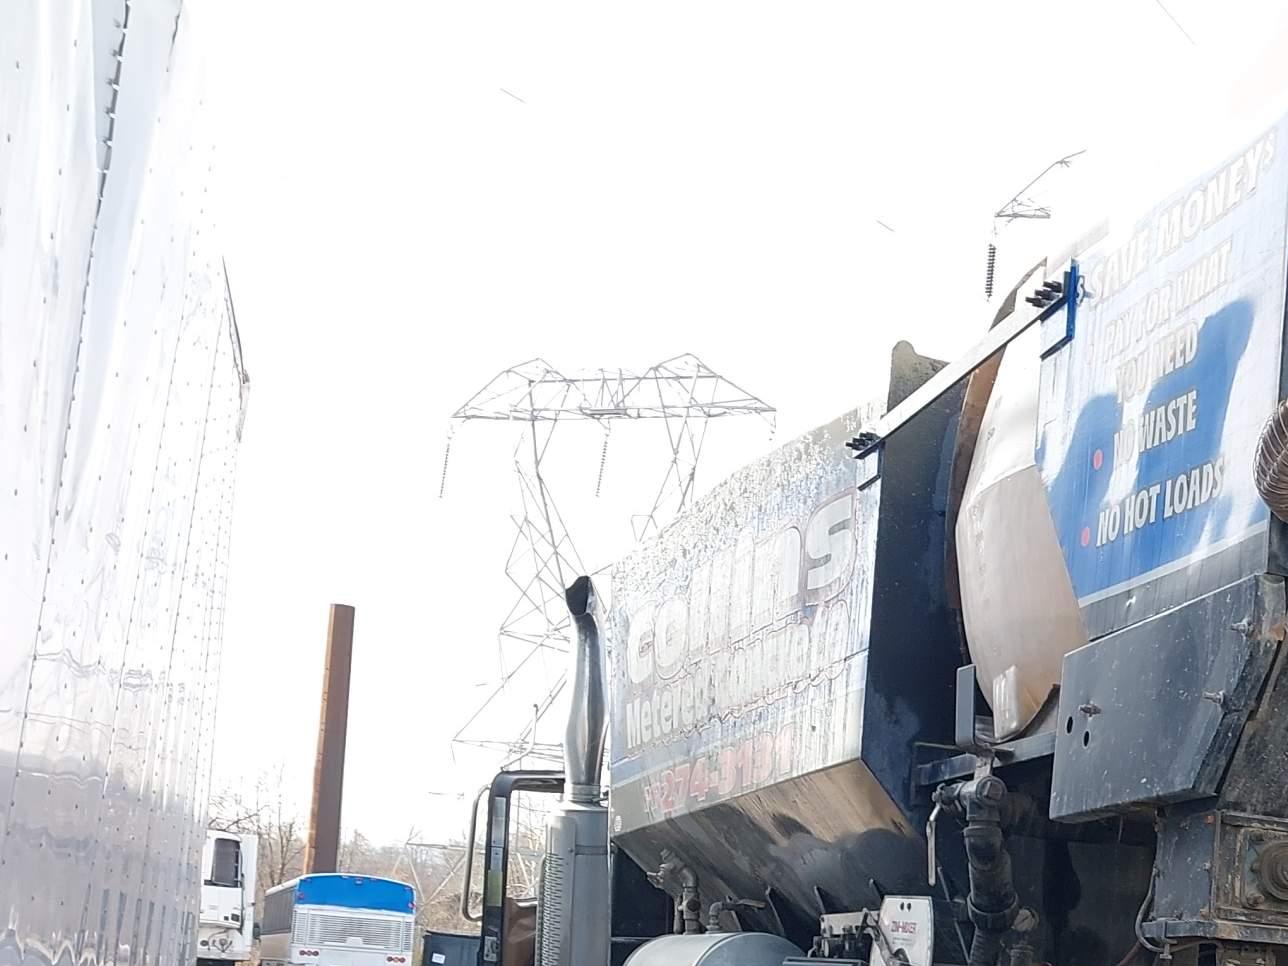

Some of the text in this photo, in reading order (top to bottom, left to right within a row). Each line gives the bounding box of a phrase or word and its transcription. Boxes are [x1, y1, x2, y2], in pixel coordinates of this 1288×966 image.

[1091, 230, 1150, 306] SAVE
[1104, 234, 1233, 364] PAY FOR WHAT
[1116, 320, 1198, 403] YOU NEED
[1113, 387, 1198, 469] NO WASTE
[1096, 455, 1226, 547] NO HOT LOADS
